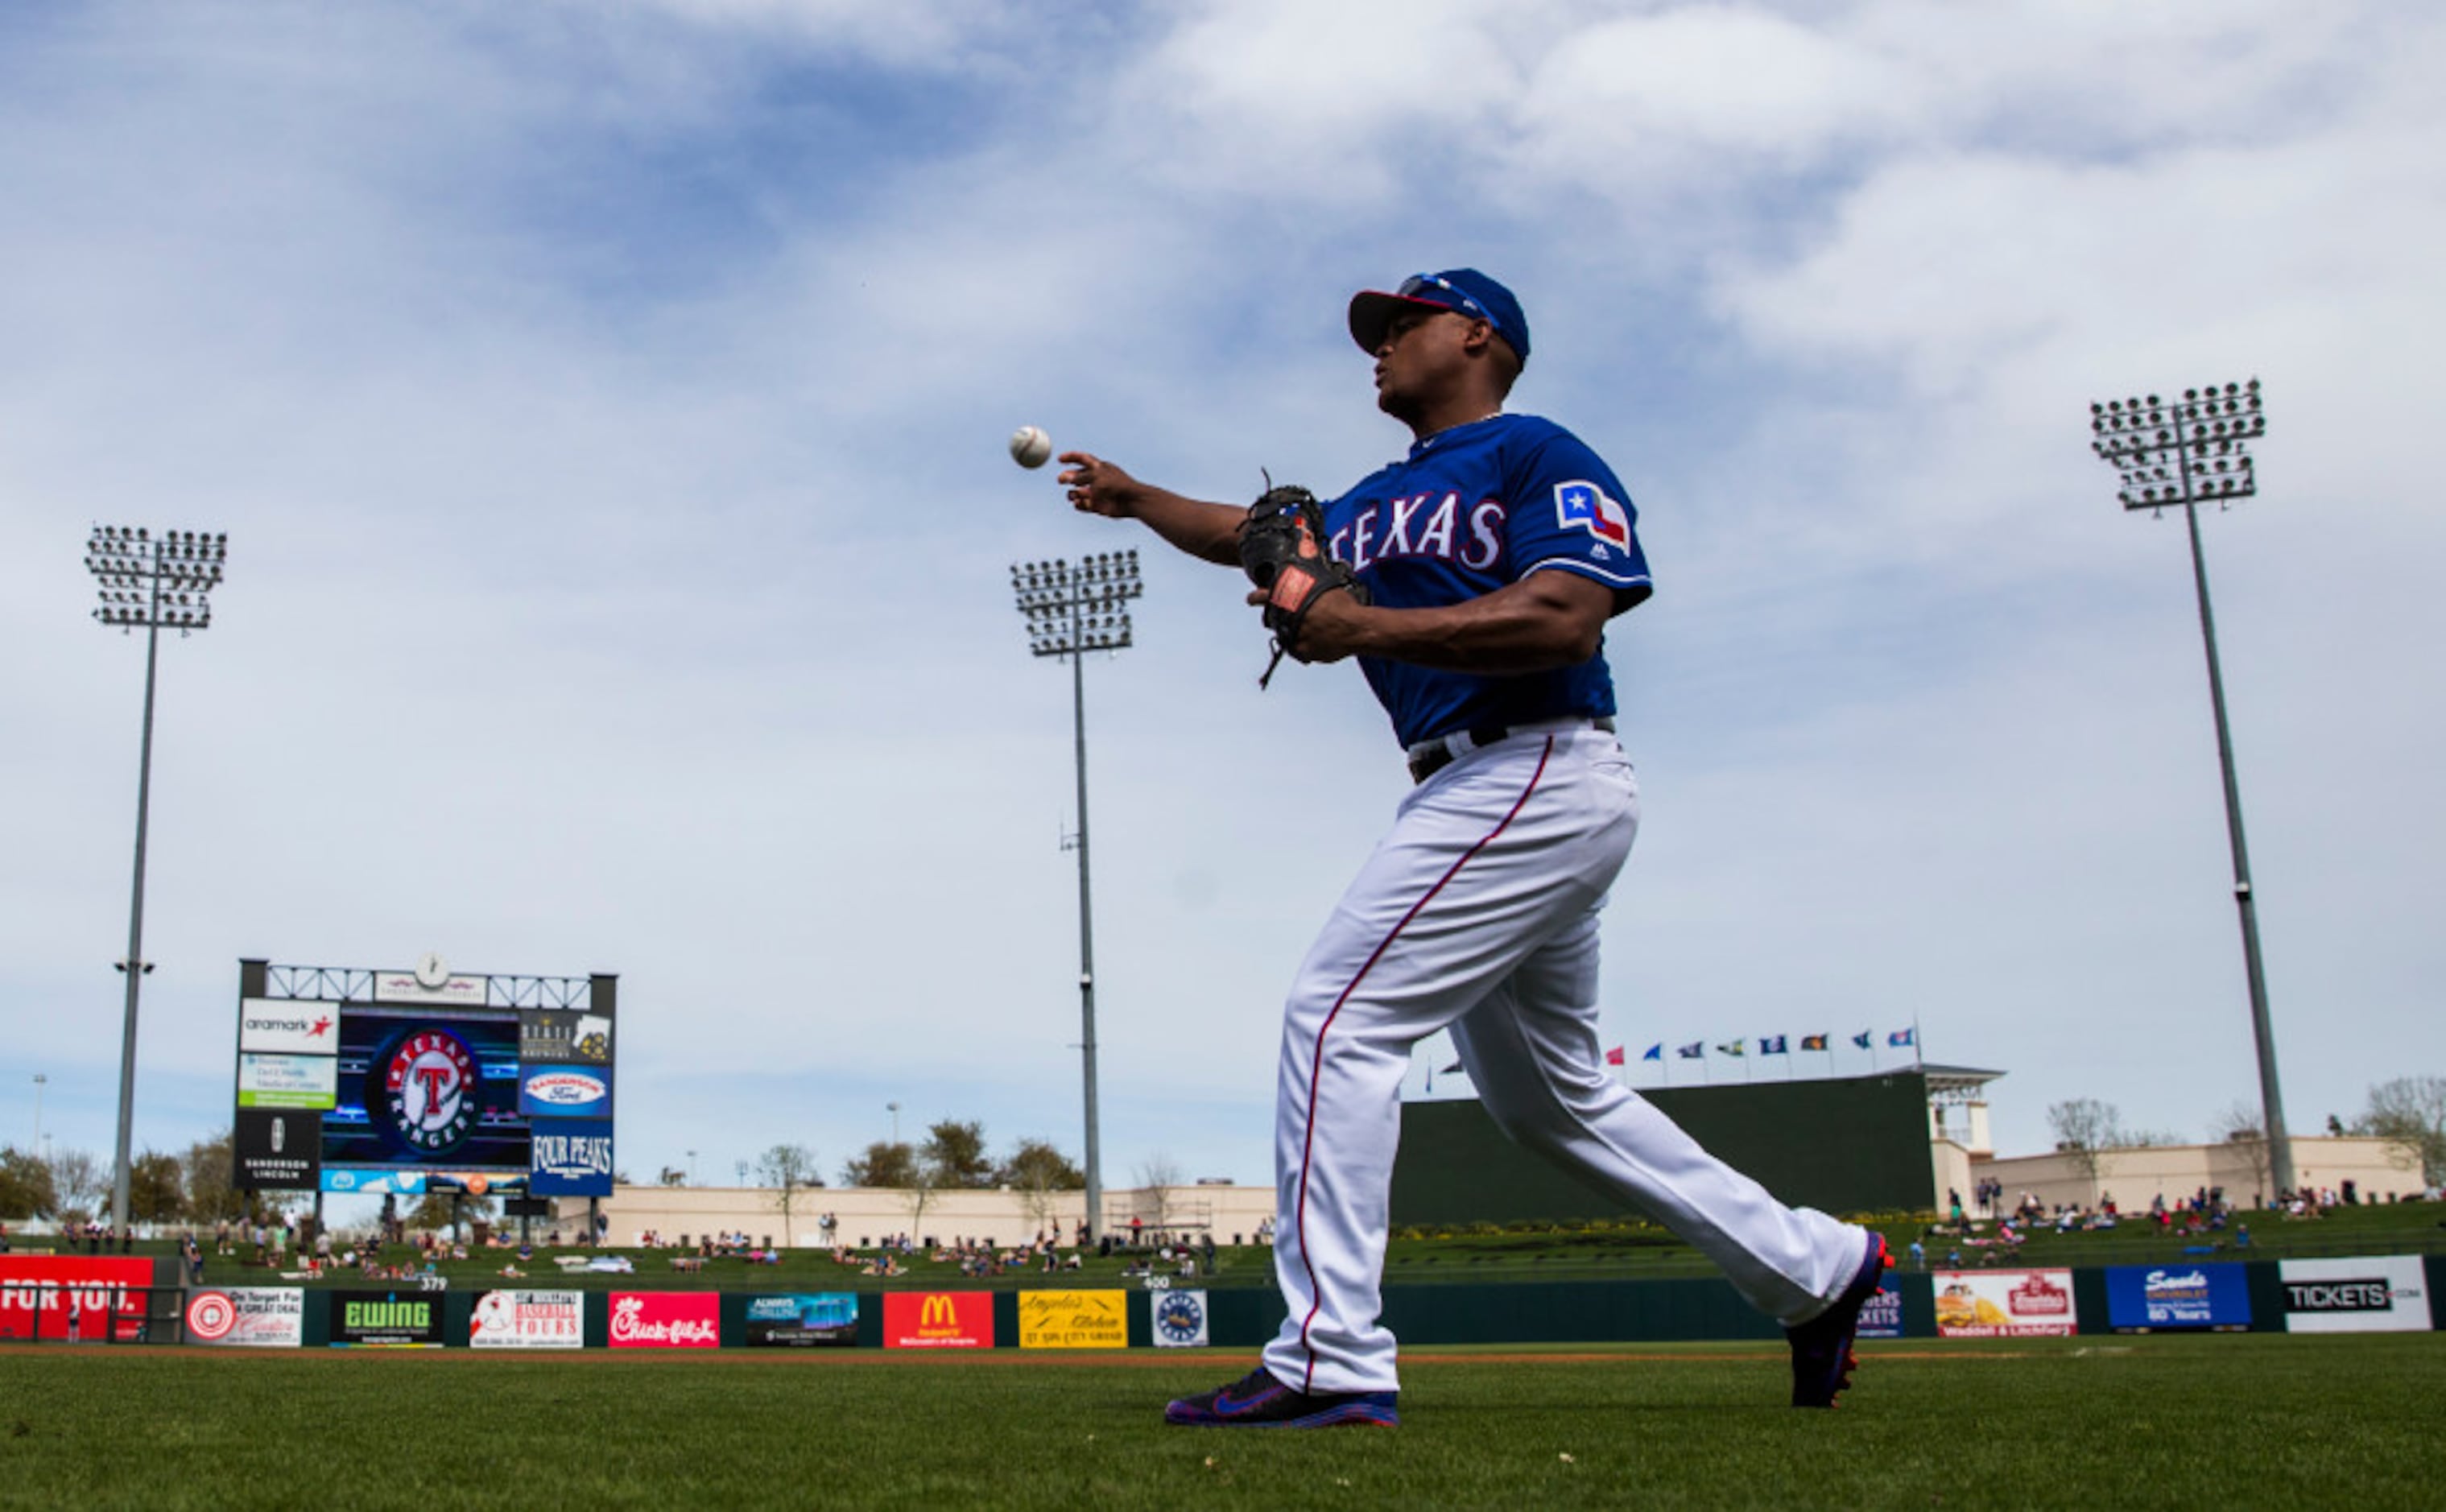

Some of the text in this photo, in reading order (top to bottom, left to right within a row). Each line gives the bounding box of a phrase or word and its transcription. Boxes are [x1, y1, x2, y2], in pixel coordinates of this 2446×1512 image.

[1329, 490, 1507, 572] TEXAS
[246, 1018, 308, 1031] aramark
[399, 1034, 469, 1068] TEXAS
[417, 1067, 451, 1115] T
[390, 1099, 475, 1148] RANGERS
[533, 1135, 611, 1175] FOUR PEAKS
[245, 1159, 309, 1170] SANDERSON
[252, 1169, 300, 1179] LINCOLN
[420, 1276, 448, 1291] 379
[1143, 1276, 1170, 1288] 400
[1, 1279, 60, 1310] FOR
[229, 1291, 300, 1303] On Target For
[1864, 1291, 1902, 1308] GERS
[754, 1298, 795, 1308] ALWAYS
[515, 1304, 576, 1319] BASEBALL
[515, 1320, 576, 1335] TOURS
